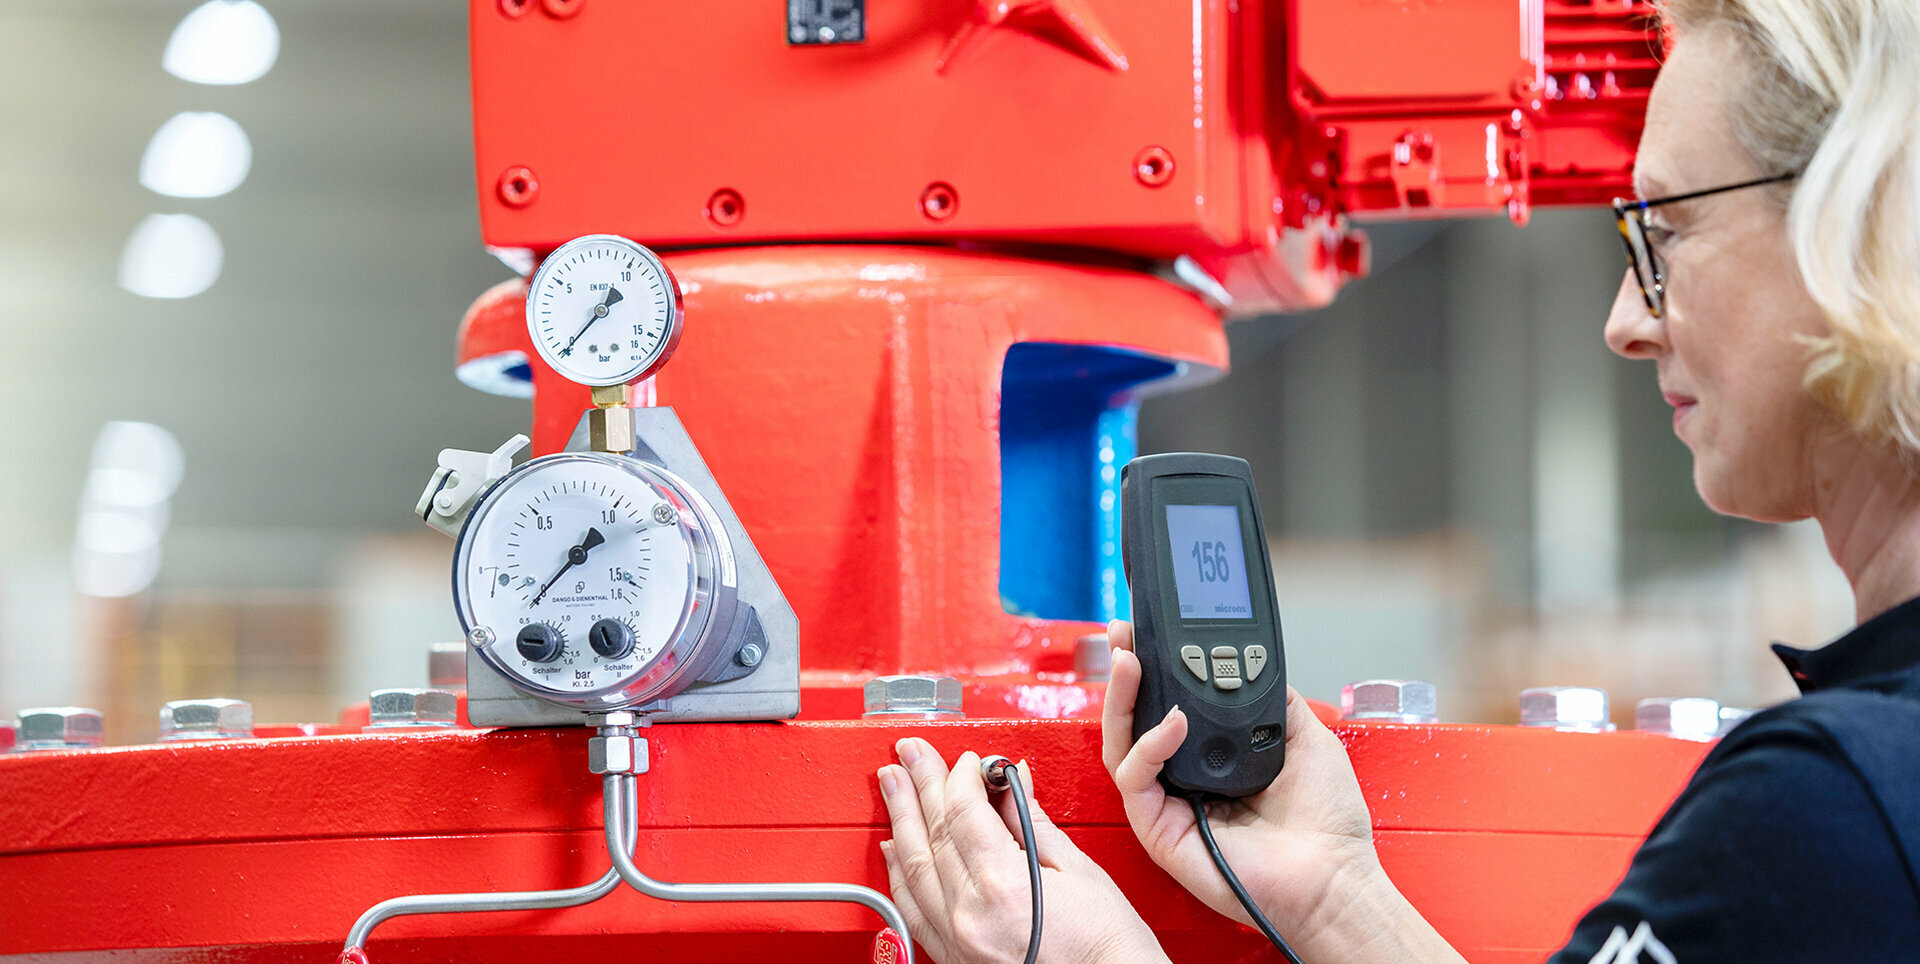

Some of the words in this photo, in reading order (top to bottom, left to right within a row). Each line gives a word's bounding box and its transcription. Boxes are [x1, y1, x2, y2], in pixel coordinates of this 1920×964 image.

[620, 271, 631, 282] 10
[566, 283, 573, 294] 5
[590, 283, 597, 291] EN
[633, 324, 643, 335] 15
[630, 340, 639, 349] 16
[599, 354, 611, 362] bar
[602, 509, 616, 525] 1,0
[537, 515, 553, 531] 0,5
[1192, 541, 1230, 583] 156
[609, 567, 622, 583] 1,5
[611, 588, 623, 601] 1,6
[1214, 603, 1247, 613] microns
[630, 610, 640, 618] 1,0
[519, 617, 530, 625] 0,5
[642, 647, 652, 655] 1,5
[564, 658, 574, 666] 1,6
[532, 667, 562, 675] Schalter
[575, 669, 591, 680] bar
